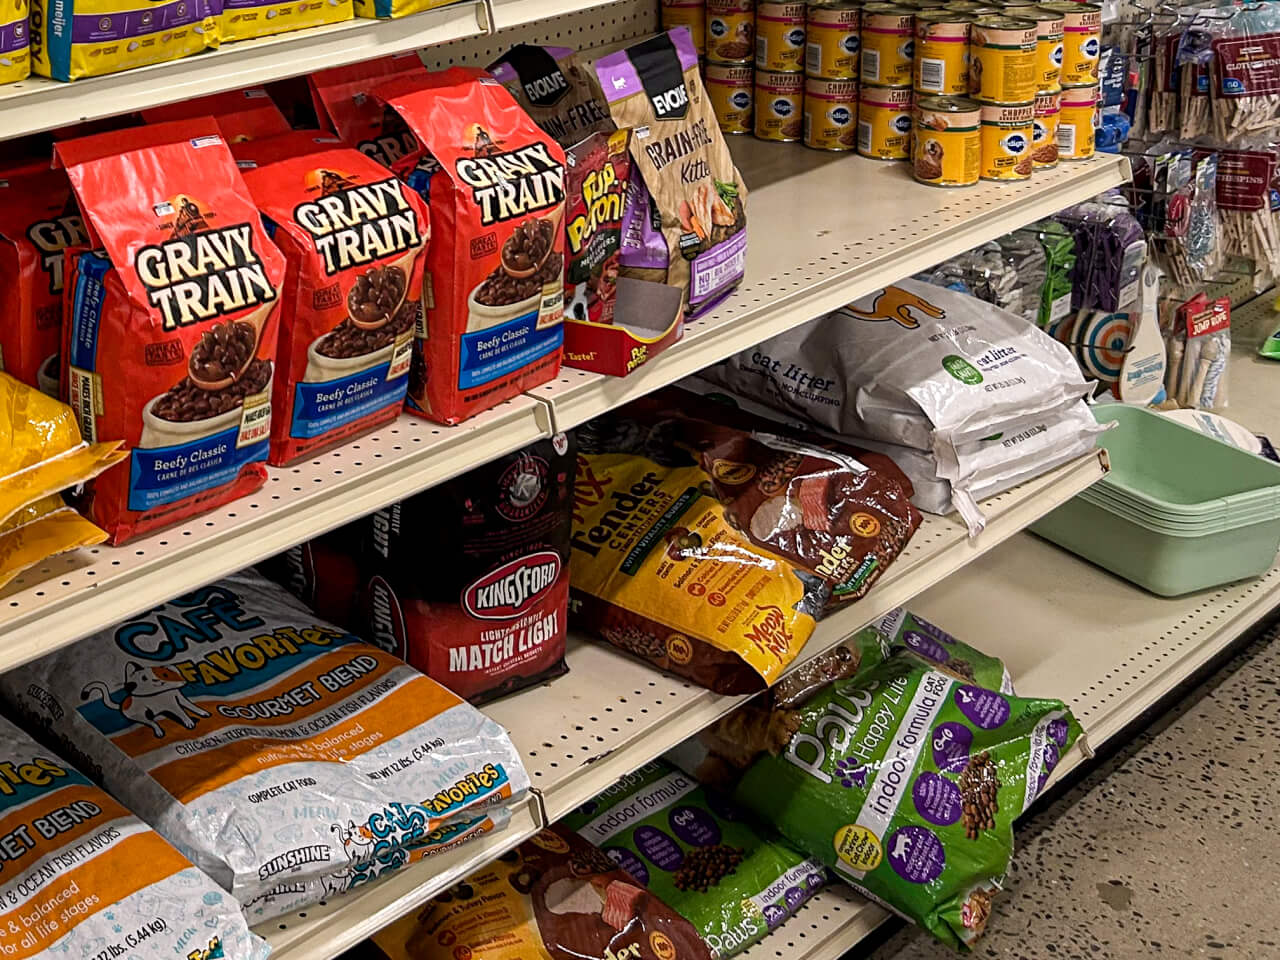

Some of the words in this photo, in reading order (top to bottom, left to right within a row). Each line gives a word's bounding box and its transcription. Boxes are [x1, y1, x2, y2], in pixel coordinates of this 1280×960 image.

[53, 0, 64, 38] meijer
[456, 143, 556, 188] GRAVY
[295, 178, 410, 235] GRAVY
[474, 167, 565, 224] TRAIN
[137, 227, 256, 288] GRAVY
[317, 211, 420, 275] TRAIN
[152, 264, 274, 330] TRAIN
[316, 385, 345, 403] Beefy
[346, 376, 378, 395] Classic
[751, 351, 781, 374] cat
[782, 363, 836, 392] litter
[154, 452, 187, 471] Beefy
[189, 442, 228, 463] Classic
[476, 562, 556, 609] KINGSFORD
[114, 601, 266, 661] CAFE
[449, 632, 514, 672] MATCH
[518, 610, 560, 653] LIGHT
[218, 682, 324, 723] GOURMET
[319, 655, 379, 693] BLEND
[923, 675, 937, 694] CAT
[854, 702, 898, 761] Happy
[869, 749, 912, 817] indoor
[898, 696, 938, 757] formula
[248, 787, 284, 805] COMPLETE
[284, 784, 298, 796] CAT
[298, 777, 317, 792] FOOD
[34, 799, 103, 844] BLEND
[258, 844, 331, 882] SUNSHINE
[17, 880, 81, 924] balanced
